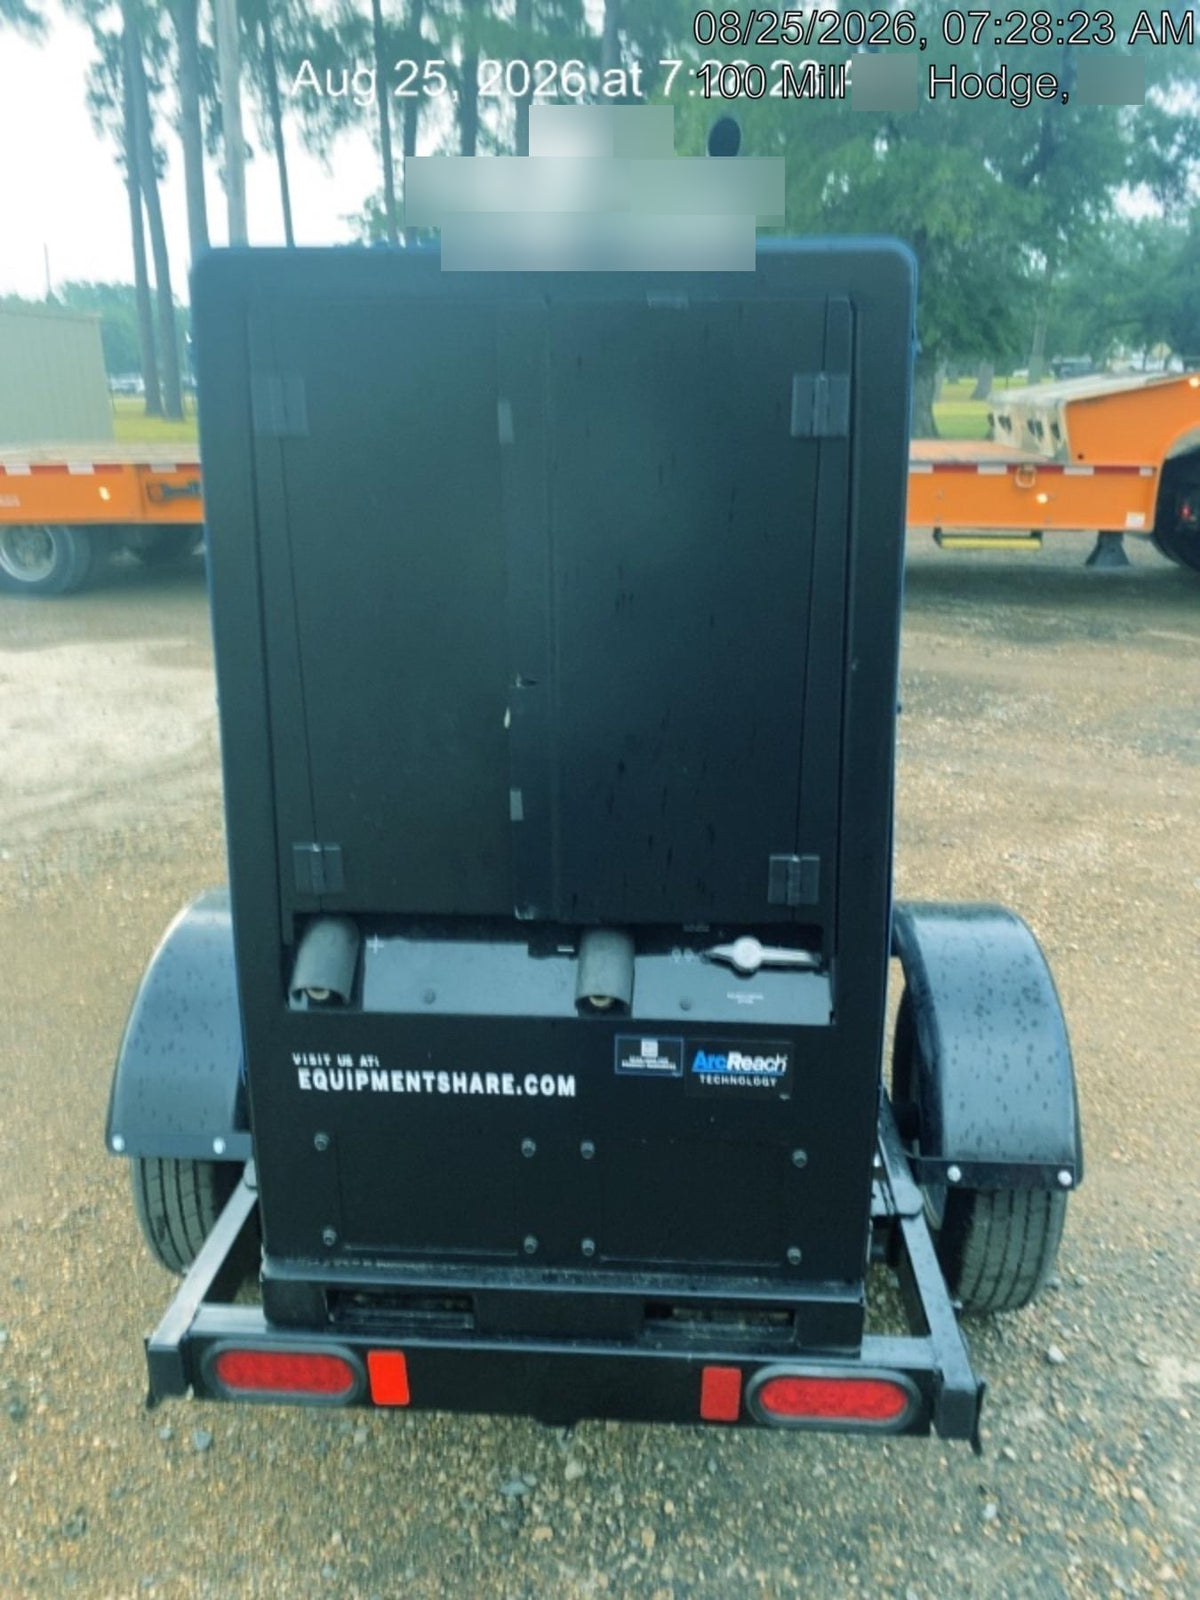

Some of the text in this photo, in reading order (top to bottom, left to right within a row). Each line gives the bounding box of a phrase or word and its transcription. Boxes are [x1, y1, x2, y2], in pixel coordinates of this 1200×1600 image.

[292, 1053, 331, 1066] VISIT
[692, 1051, 788, 1074] ArcReach
[298, 1068, 577, 1097] EQUIPMENTSHARE.COM
[700, 1074, 778, 1087] TECHNOLOGY
